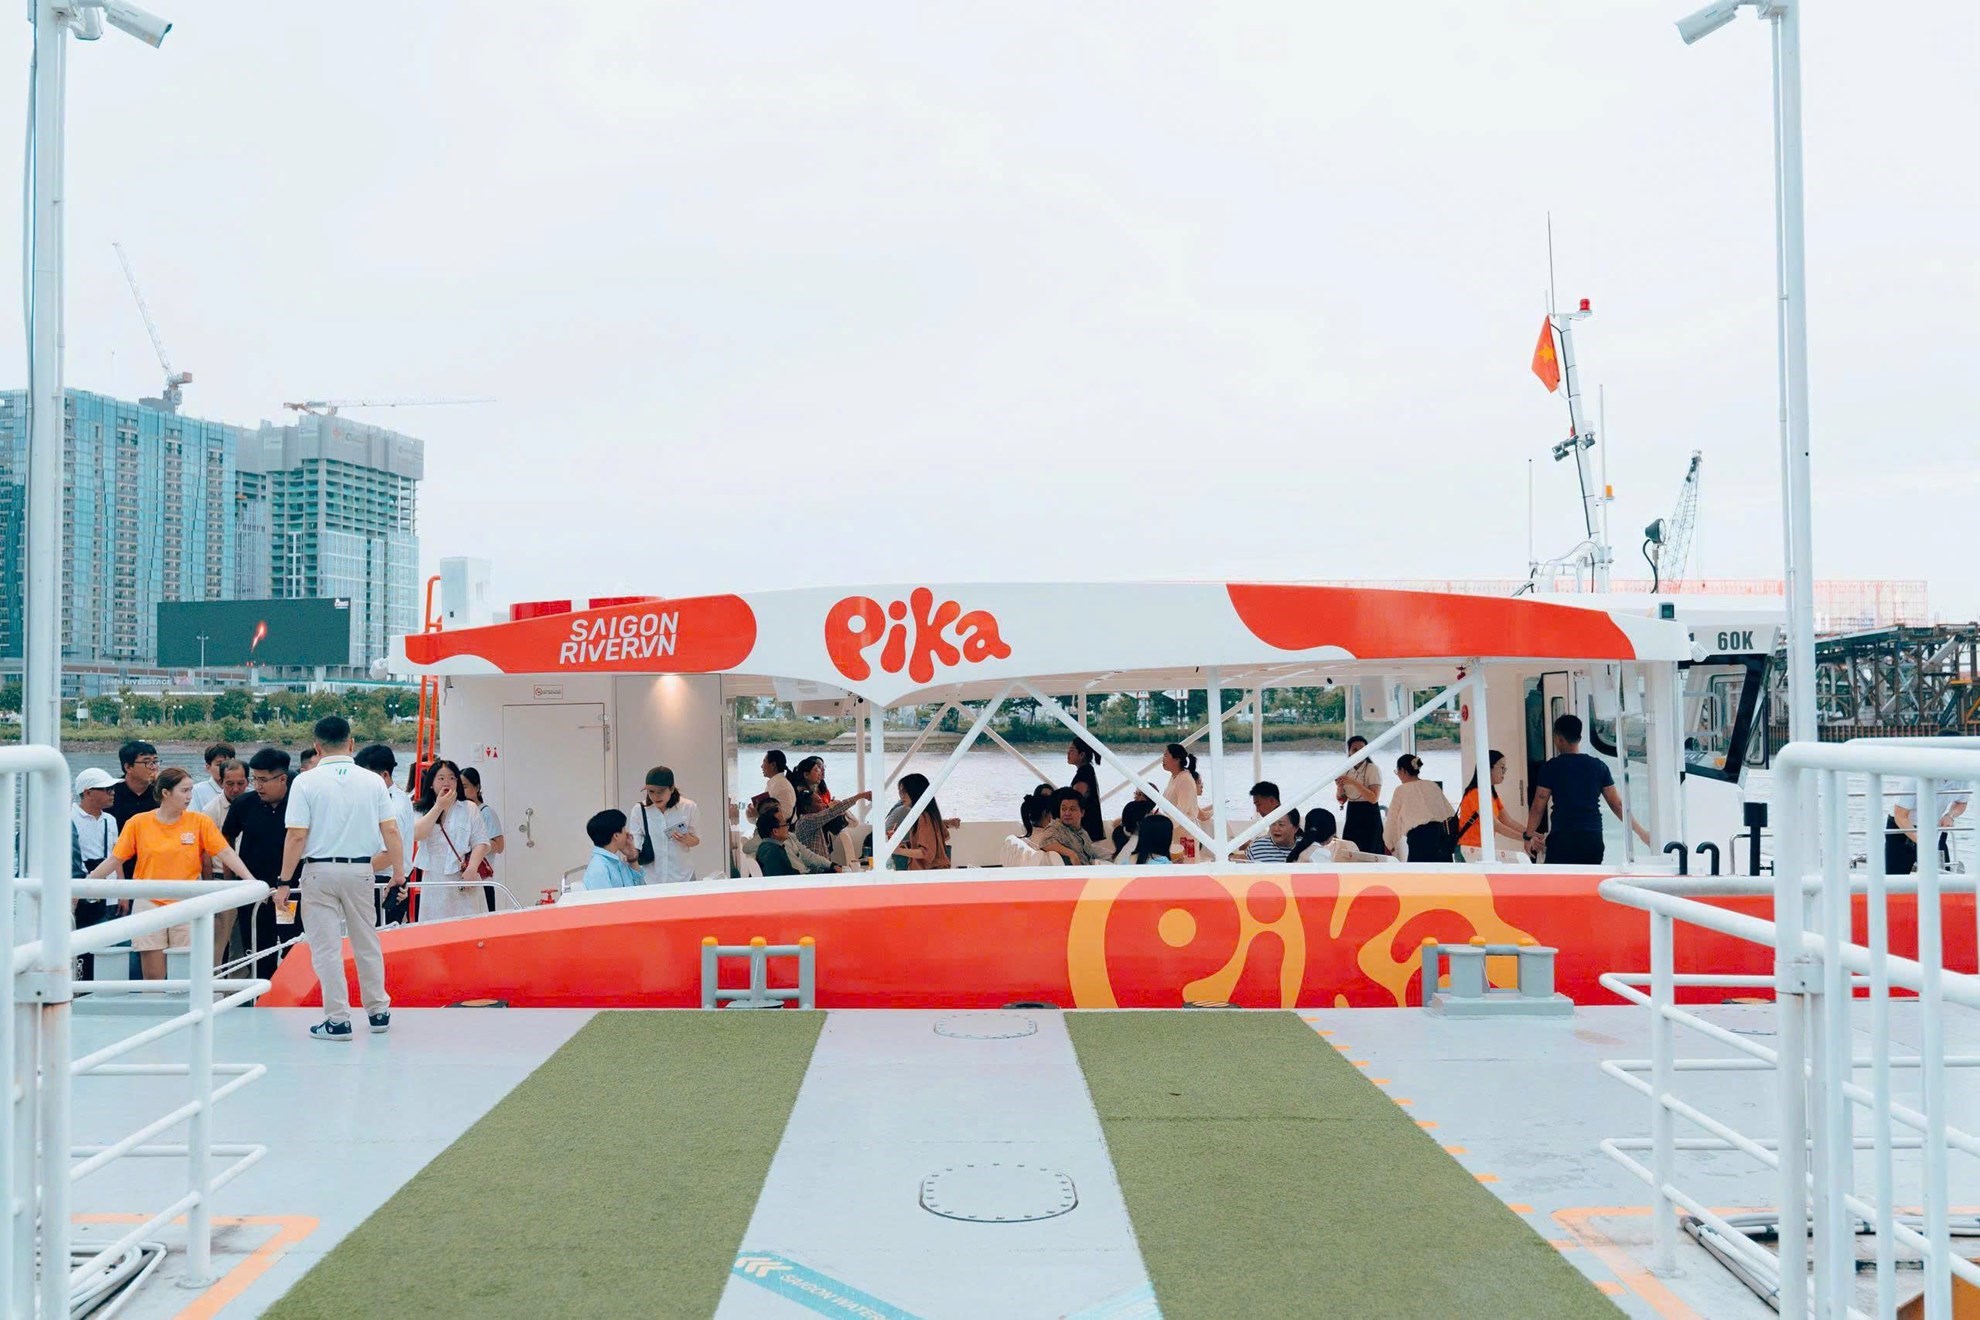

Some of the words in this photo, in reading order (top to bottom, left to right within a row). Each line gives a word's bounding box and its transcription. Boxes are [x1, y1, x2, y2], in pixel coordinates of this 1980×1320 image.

[570, 612, 679, 641] SAIGON
[1717, 631, 1753, 650] 60K
[560, 634, 676, 664] RIVER.VN
